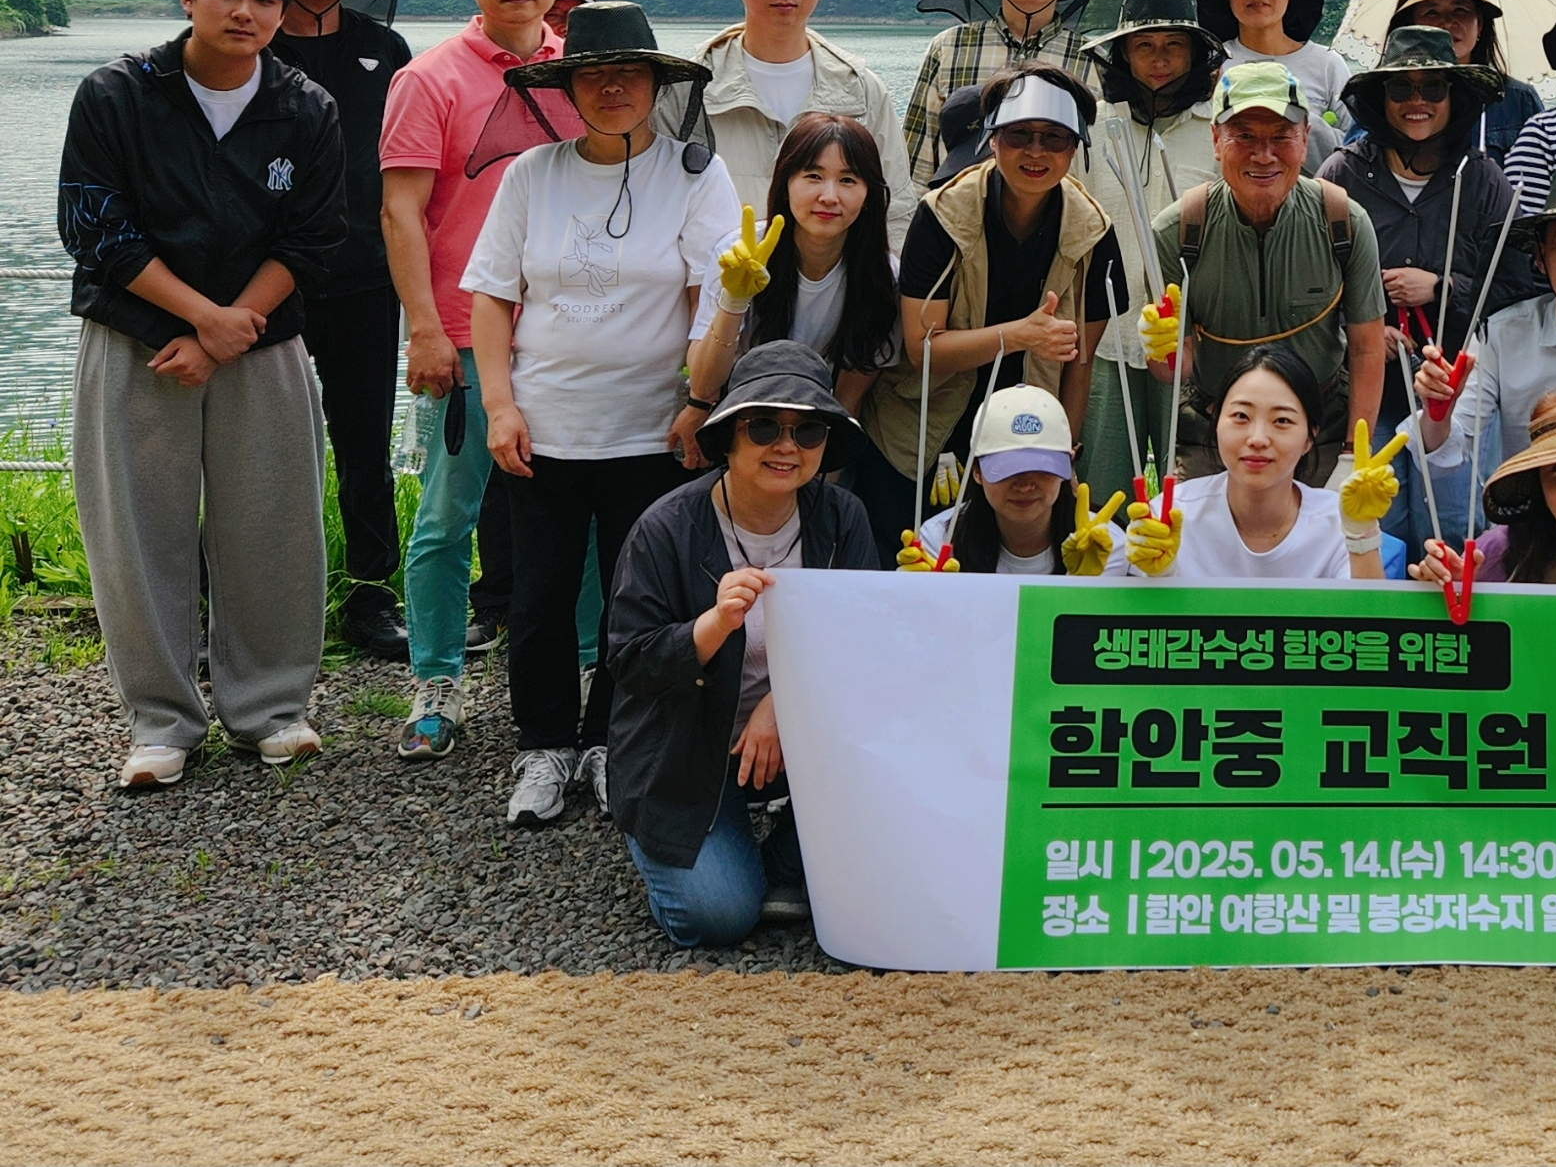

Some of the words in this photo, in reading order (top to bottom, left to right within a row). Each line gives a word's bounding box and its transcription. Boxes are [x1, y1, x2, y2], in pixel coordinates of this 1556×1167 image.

[1092, 628, 1275, 671] 생태감수성
[1282, 629, 1391, 672] 함양을
[1398, 631, 1472, 675] 위한
[1048, 705, 1284, 789] 함안중
[1319, 710, 1548, 790] 교직원
[1045, 839, 1114, 881] 일시
[1147, 840, 1263, 879] 2025.
[1270, 840, 1334, 879] 05.
[1340, 839, 1446, 880] 14.(수)
[1042, 893, 1111, 937] 장소
[1145, 893, 1214, 935] 함안
[1219, 893, 1322, 935] 여항산
[1326, 893, 1361, 934] 및
[1367, 893, 1535, 934] 봉성저수지
